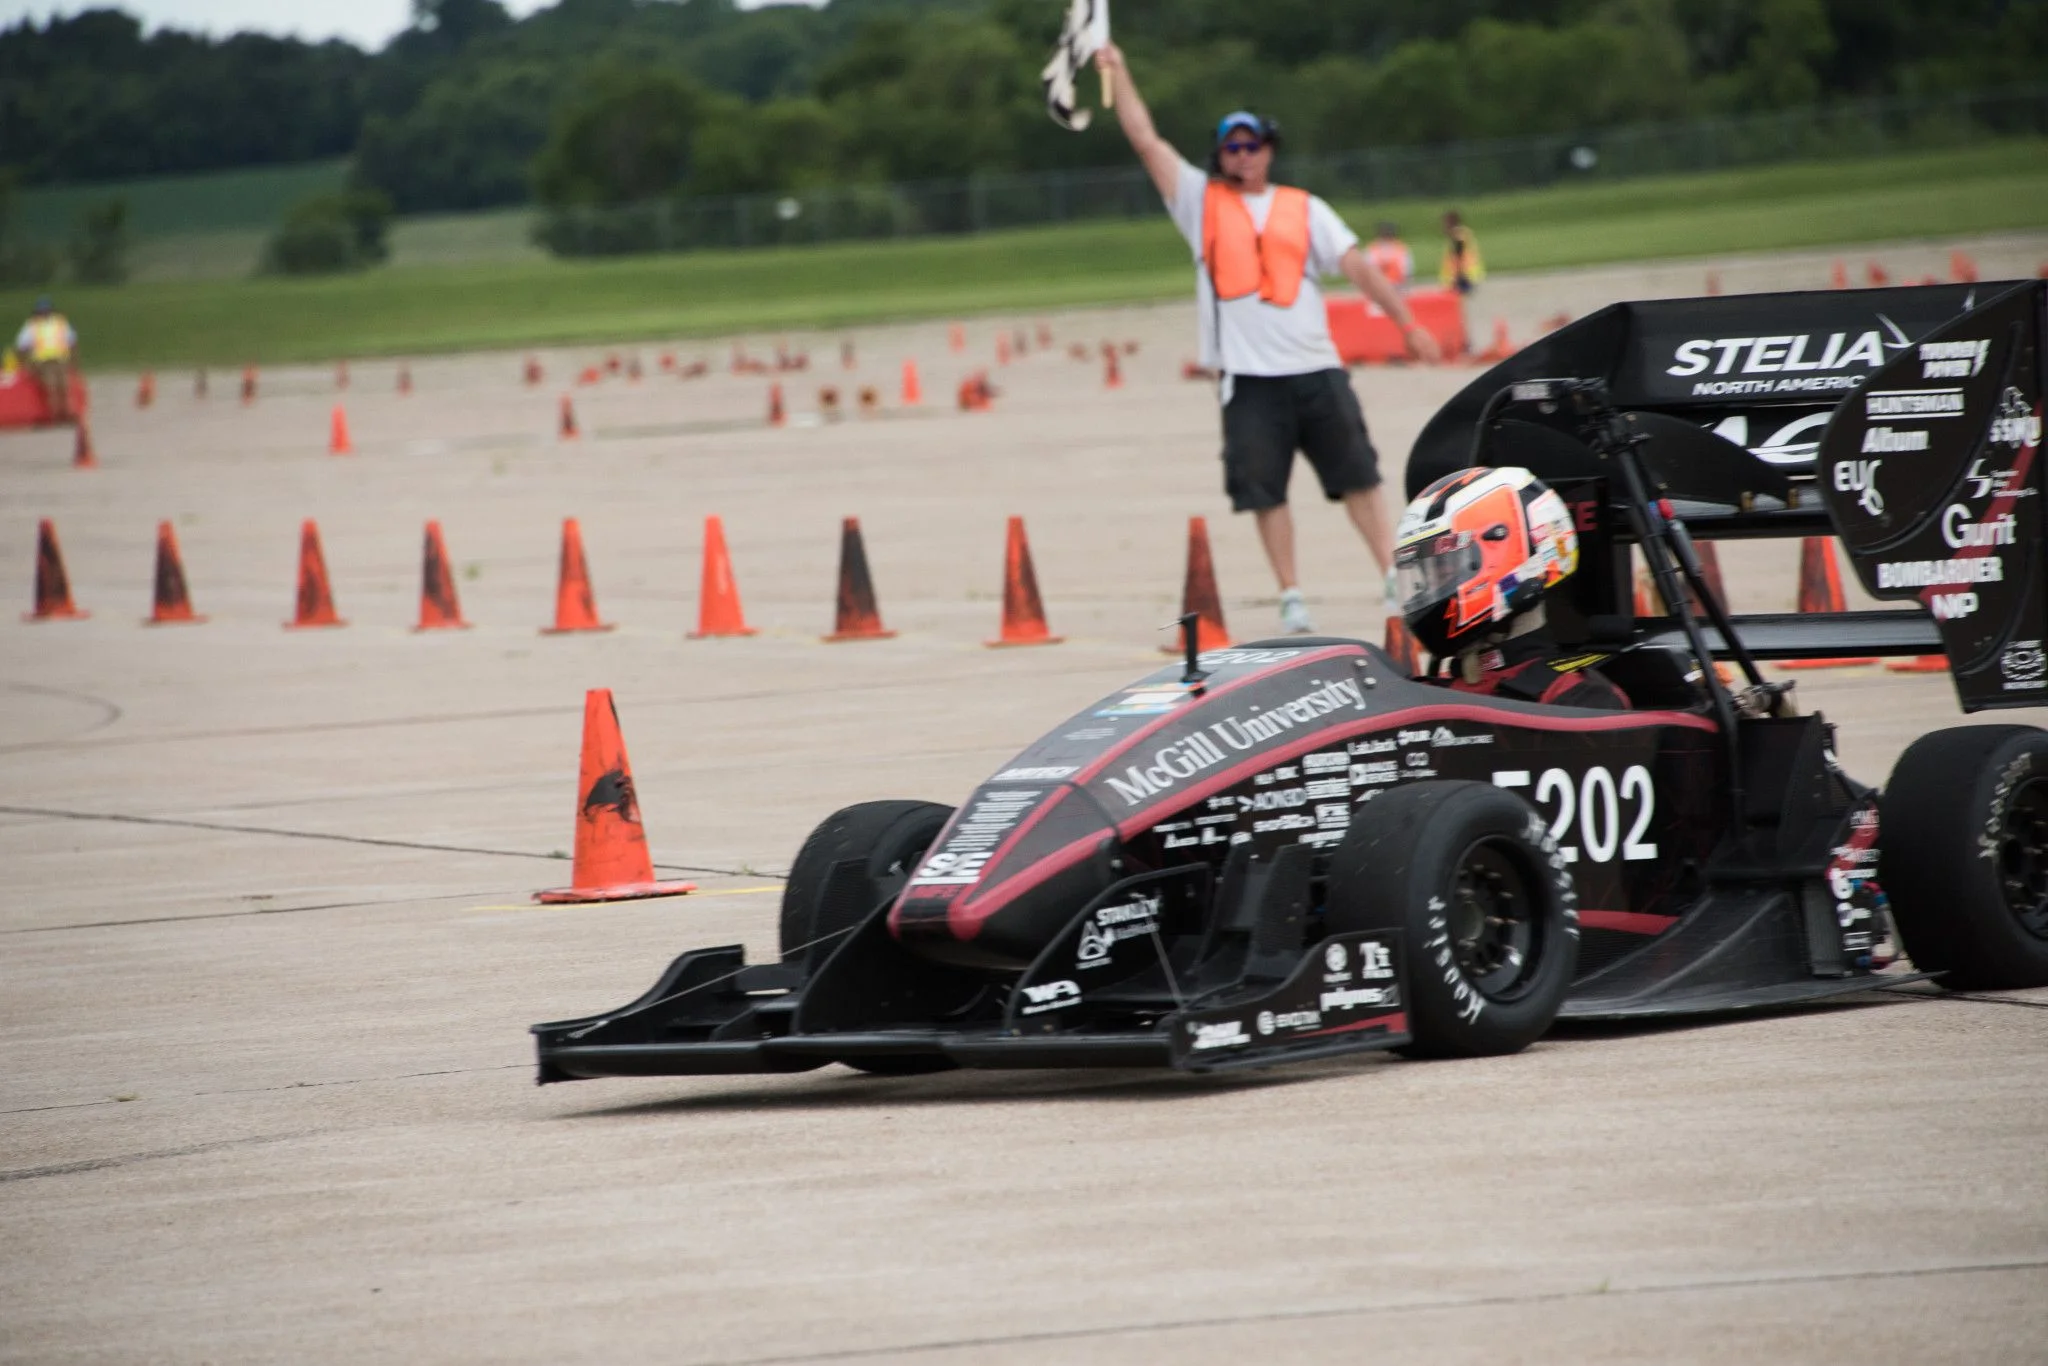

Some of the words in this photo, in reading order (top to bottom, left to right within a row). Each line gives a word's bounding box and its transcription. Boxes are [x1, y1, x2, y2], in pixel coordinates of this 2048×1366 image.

[1666, 331, 1885, 376] STELIA
[1692, 378, 1772, 396] NORTH
[1773, 375, 1865, 393] AMERIC
[1941, 503, 2017, 549] Gurit
[1103, 732, 1228, 807] McGill
[1209, 676, 1366, 750] University
